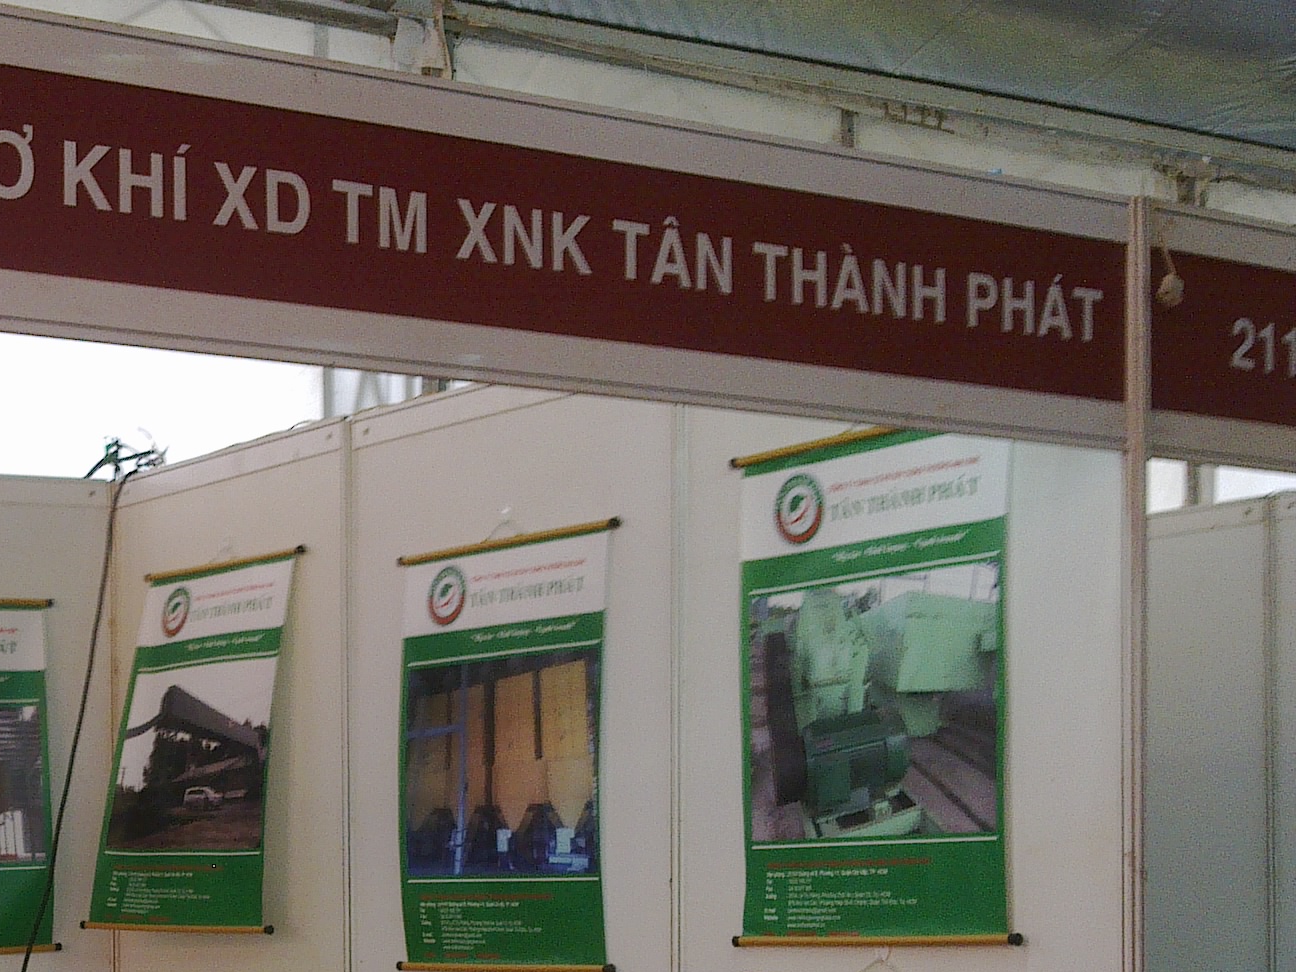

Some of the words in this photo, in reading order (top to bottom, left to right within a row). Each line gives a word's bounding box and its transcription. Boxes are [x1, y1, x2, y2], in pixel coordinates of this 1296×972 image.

[64, 143, 191, 222] KHÍ
[213, 161, 311, 235] XD
[332, 179, 428, 254] TM
[455, 197, 592, 275] XNK
[612, 216, 735, 296] TÂN
[753, 242, 948, 325] THÀNH
[964, 272, 1103, 343] PHÁT
[1229, 316, 1296, 379] 211
